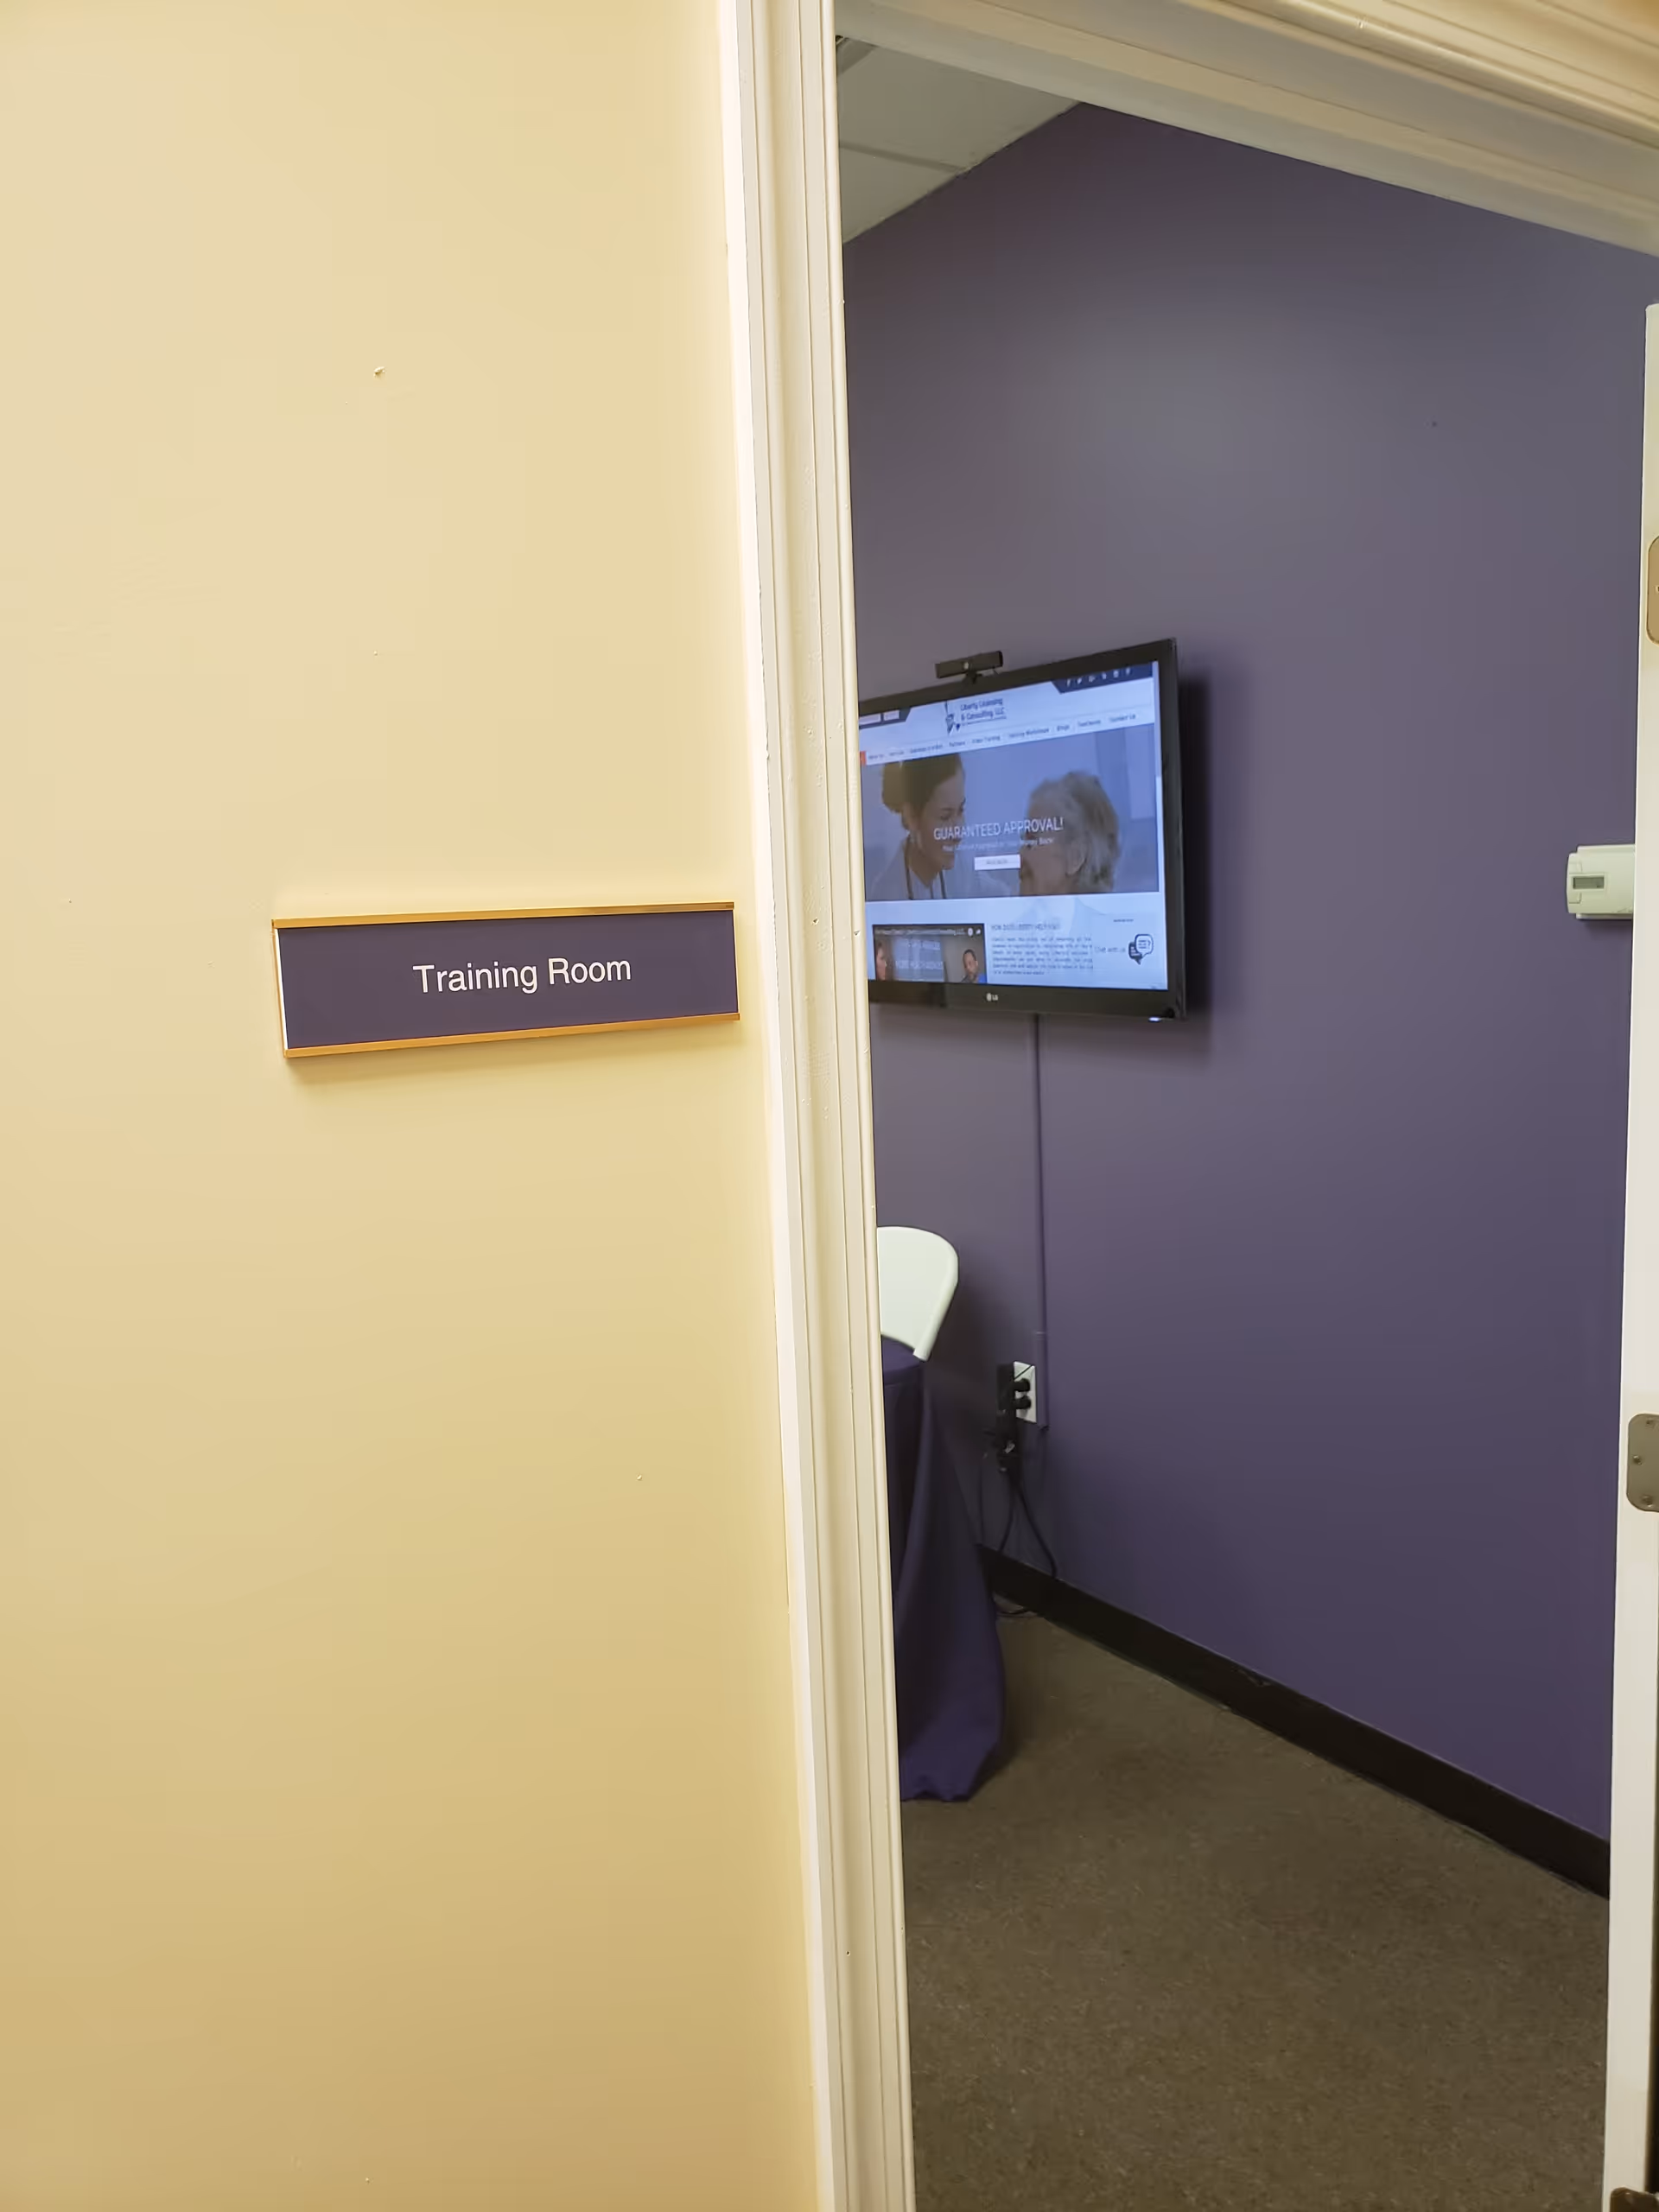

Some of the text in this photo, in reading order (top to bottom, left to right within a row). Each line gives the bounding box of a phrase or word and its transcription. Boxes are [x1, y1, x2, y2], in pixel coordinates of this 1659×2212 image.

[933, 817, 1064, 840] GUARANTEED APPROVAL!
[412, 957, 632, 995] Training Room
